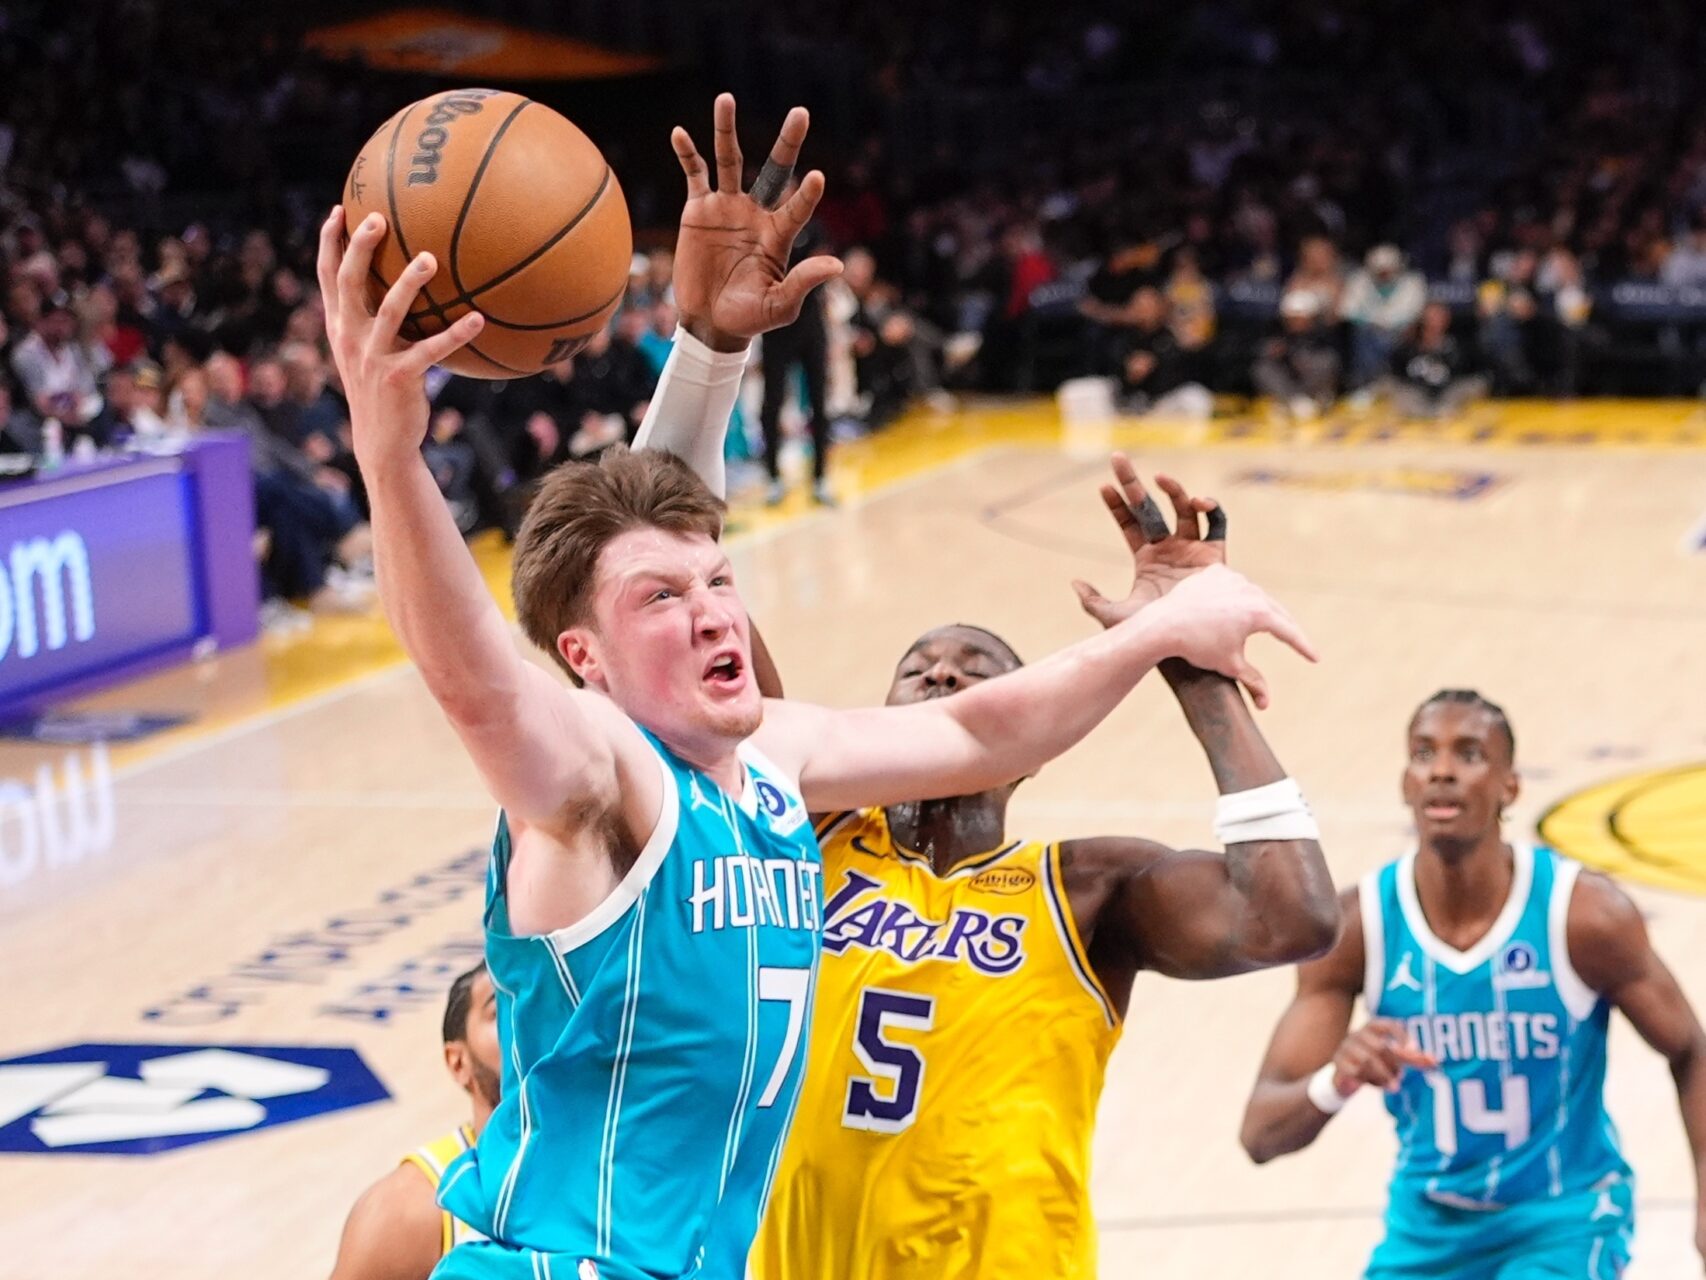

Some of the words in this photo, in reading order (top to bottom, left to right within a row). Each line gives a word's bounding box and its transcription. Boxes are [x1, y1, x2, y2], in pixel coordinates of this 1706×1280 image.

[408, 87, 499, 187] ilson
[687, 855, 822, 933] HORNET
[822, 870, 1026, 976] LAKERS
[756, 966, 811, 1108] 7
[841, 985, 936, 1134] 5
[1407, 1012, 1559, 1060] ORNETS
[1425, 1070, 1531, 1156] 14
